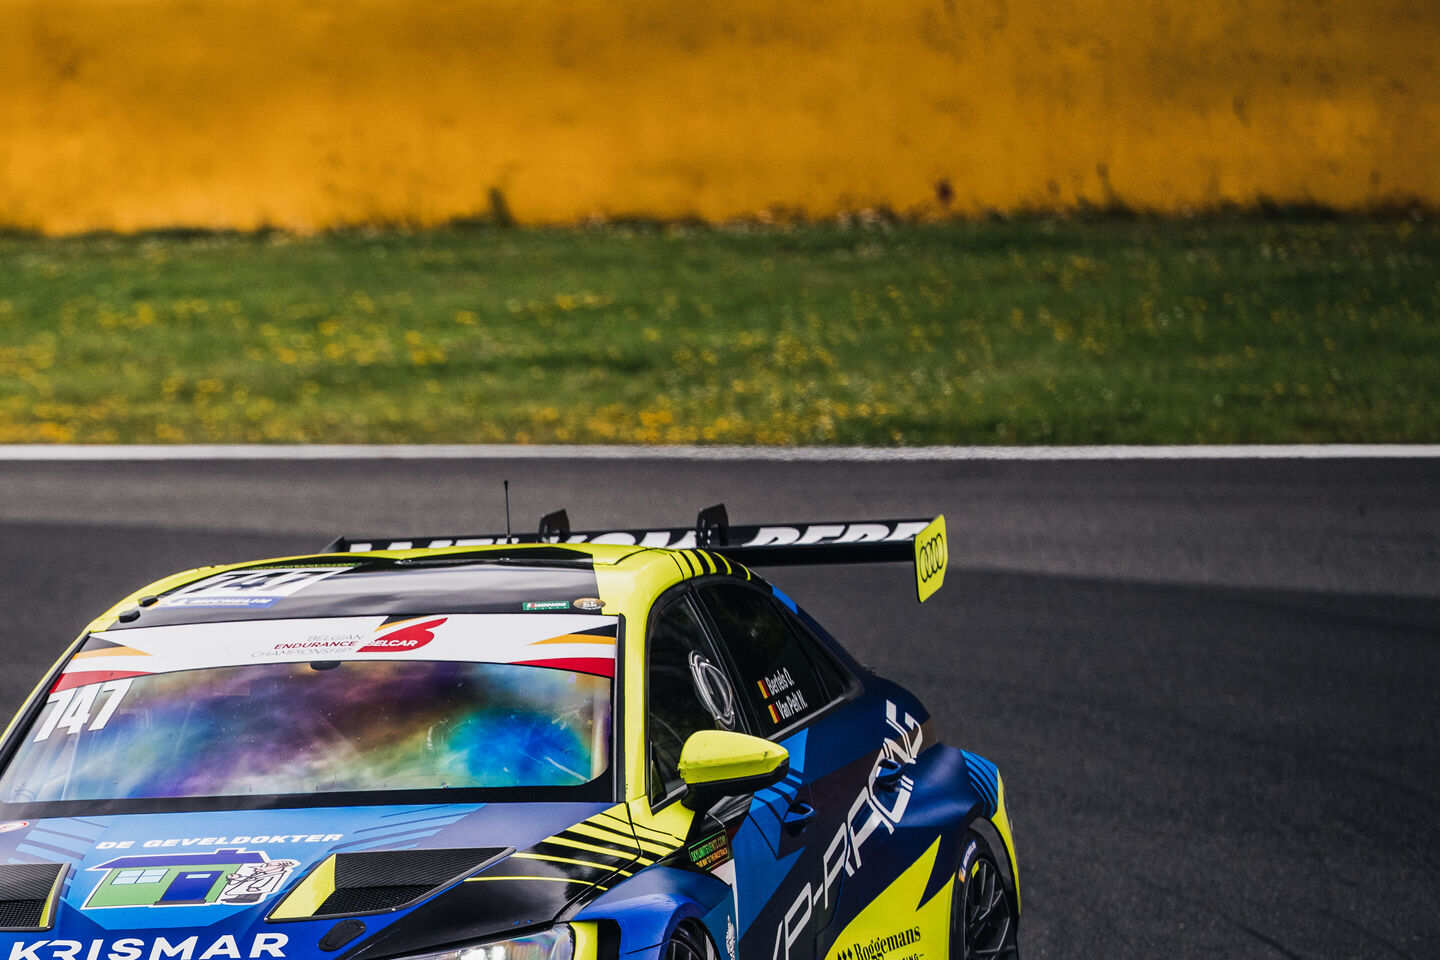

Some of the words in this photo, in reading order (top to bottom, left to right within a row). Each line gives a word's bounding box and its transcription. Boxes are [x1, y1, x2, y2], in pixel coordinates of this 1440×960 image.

[307, 634, 365, 642] BELGIAN
[273, 641, 359, 650] ENDURANCE
[251, 648, 353, 658] CHAMPIONSHIP
[33, 678, 134, 743] 747
[775, 700, 792, 719] Van
[786, 691, 803, 715] Pelt
[95, 840, 135, 850] DE
[143, 834, 344, 848] GEVELDOKTER
